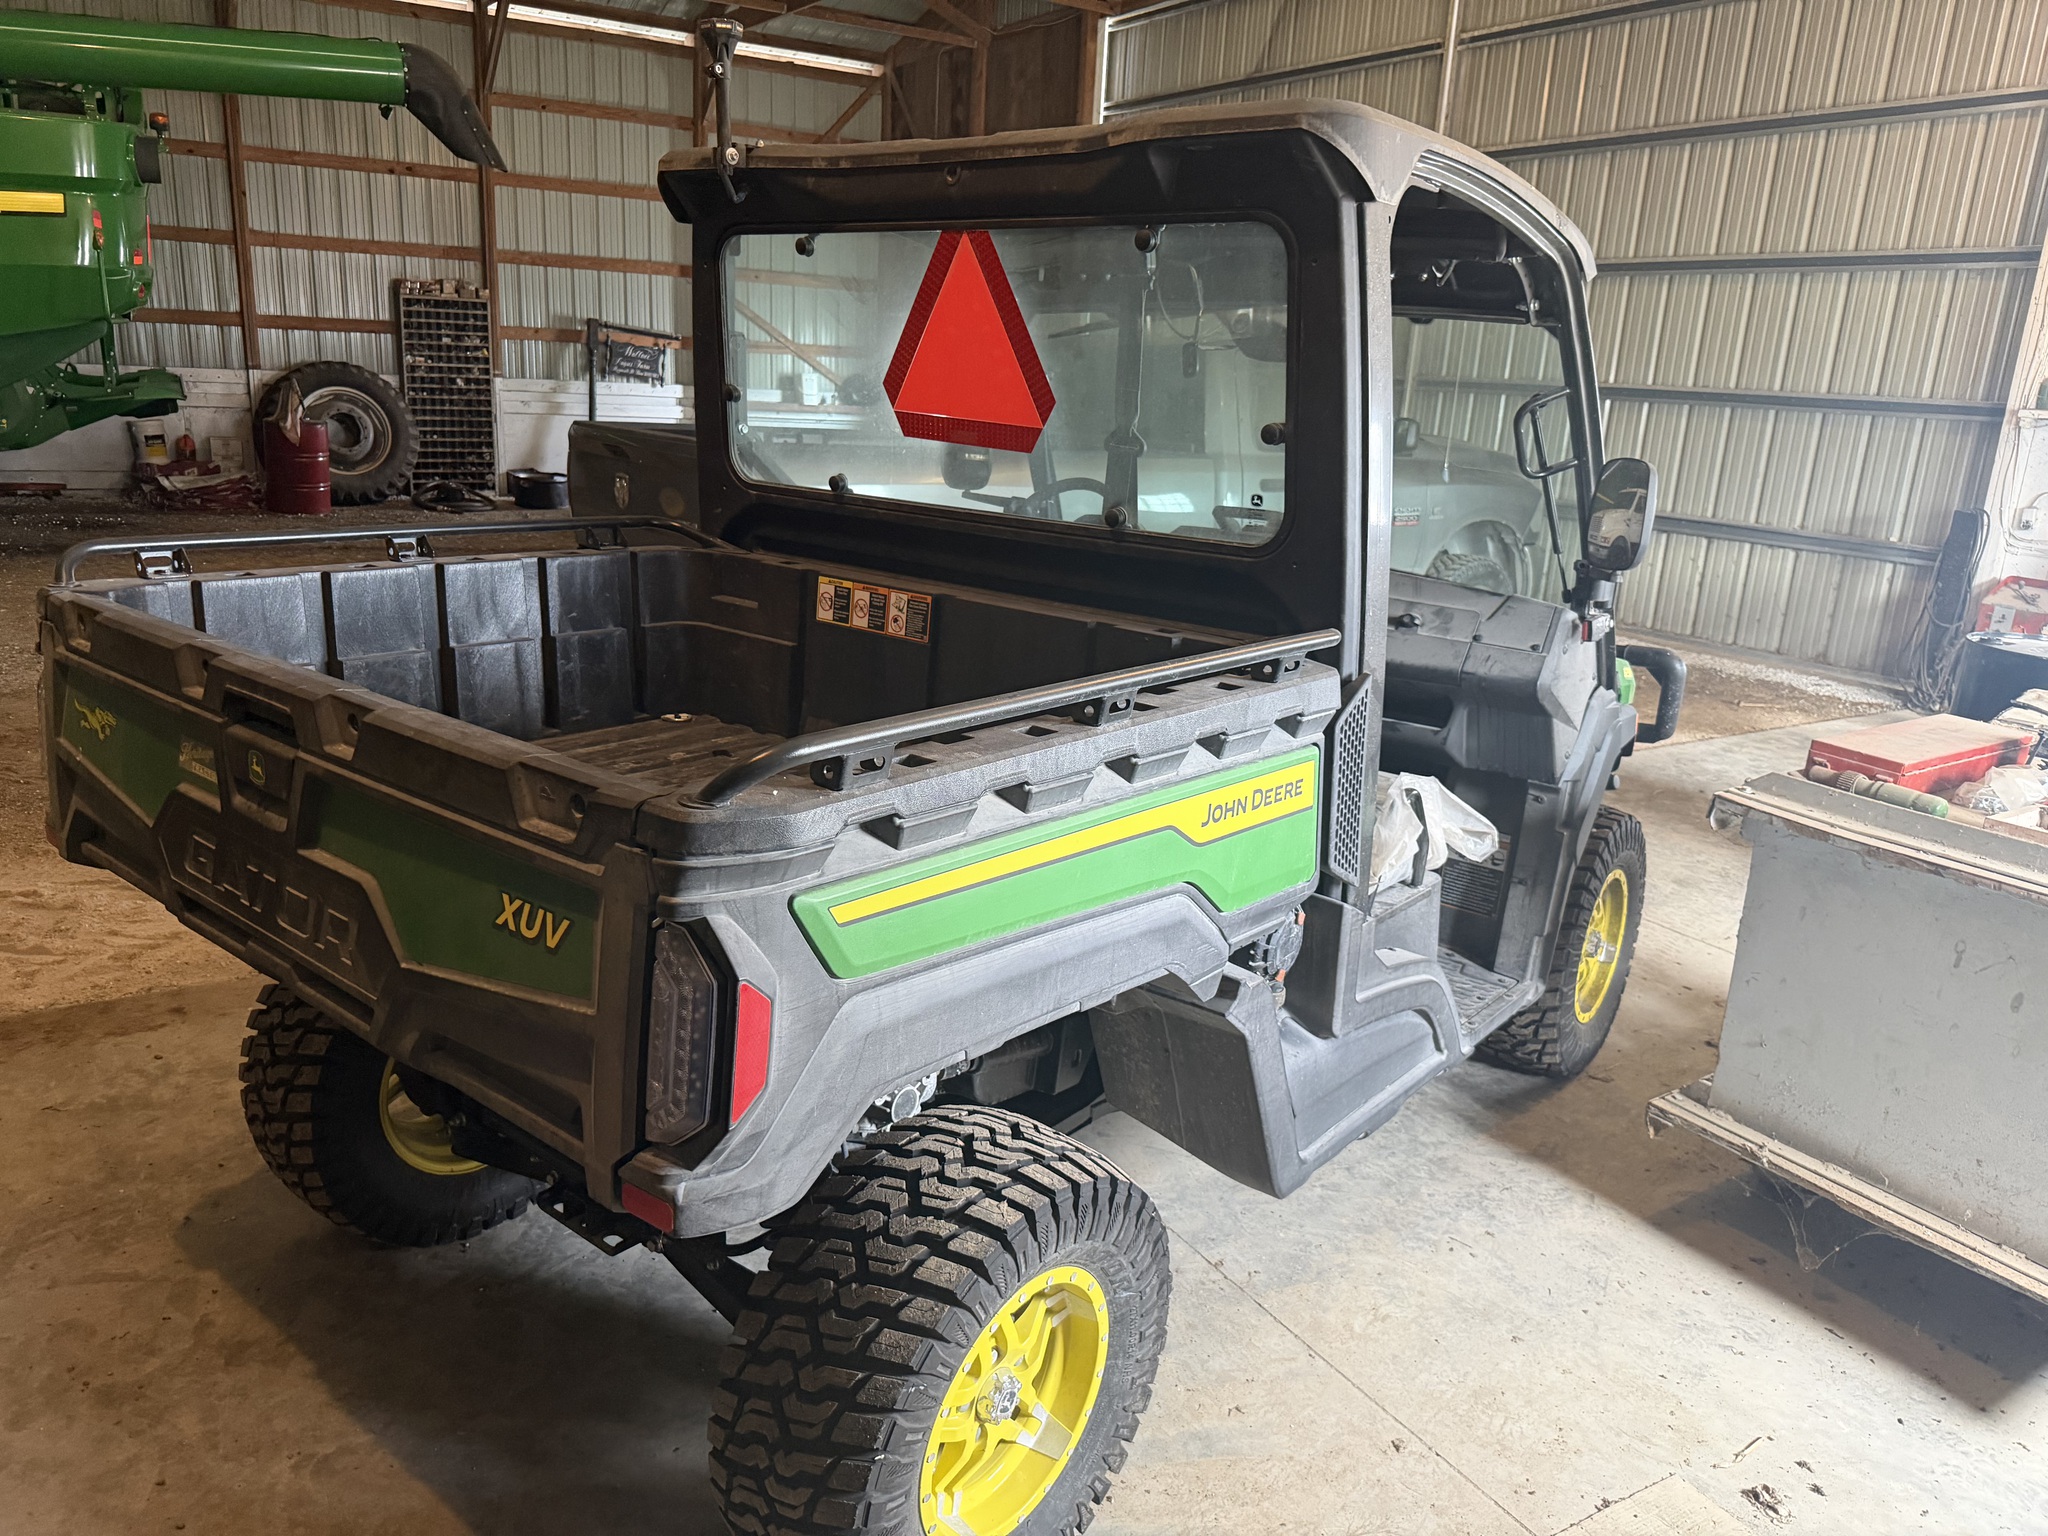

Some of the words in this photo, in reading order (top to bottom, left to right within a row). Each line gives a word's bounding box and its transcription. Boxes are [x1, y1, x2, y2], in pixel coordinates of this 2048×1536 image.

[1201, 796, 1248, 828] JOHN
[1251, 778, 1304, 811] DEERE
[184, 834, 358, 967] GATOR
[495, 892, 571, 949] XUV
